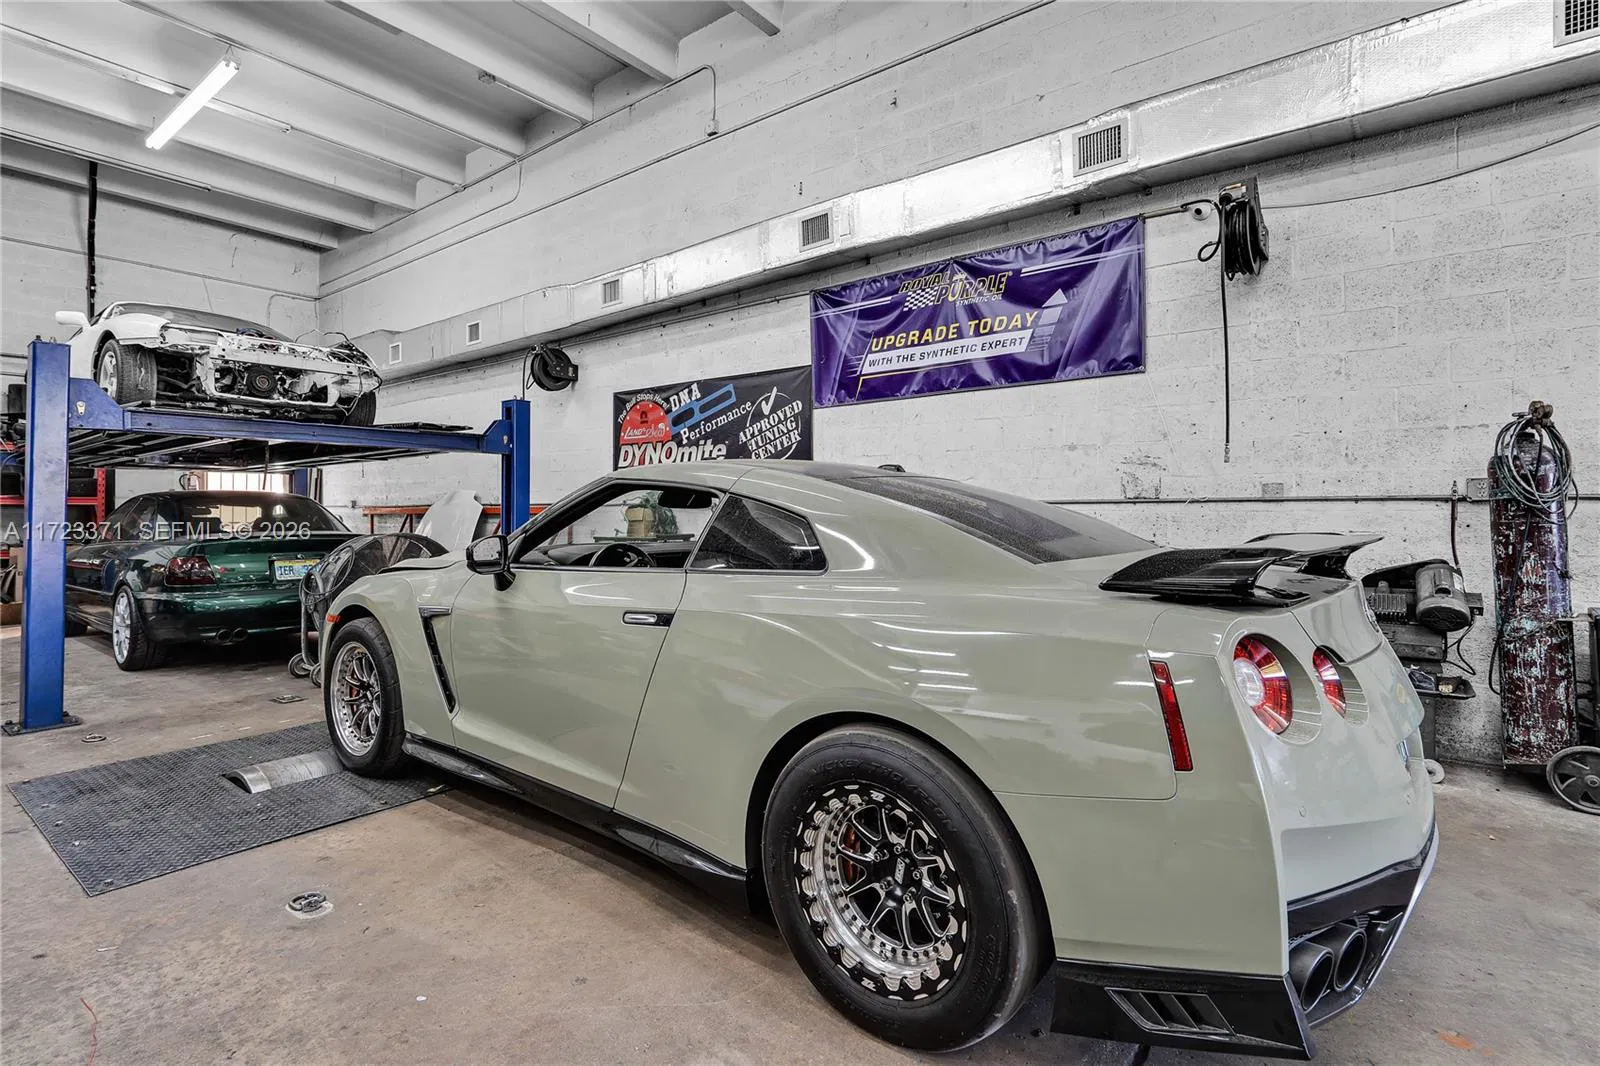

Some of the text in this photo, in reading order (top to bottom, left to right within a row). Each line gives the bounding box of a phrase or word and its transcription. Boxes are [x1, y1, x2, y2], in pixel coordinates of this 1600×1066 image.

[899, 271, 950, 294] ROYAL
[934, 271, 1009, 305] PURPLE
[955, 295, 989, 307] SYNTHETIC
[871, 311, 1040, 352] UPGRADE TODAY
[868, 336, 1026, 368] WITH THE SYNTHETIC EXPERT
[669, 383, 702, 412] DNA
[680, 401, 753, 445] Performance
[738, 400, 803, 445] APPROVED
[747, 417, 797, 453] TUNING
[618, 439, 726, 468] DYNOmite
[751, 429, 802, 460] CENTER
